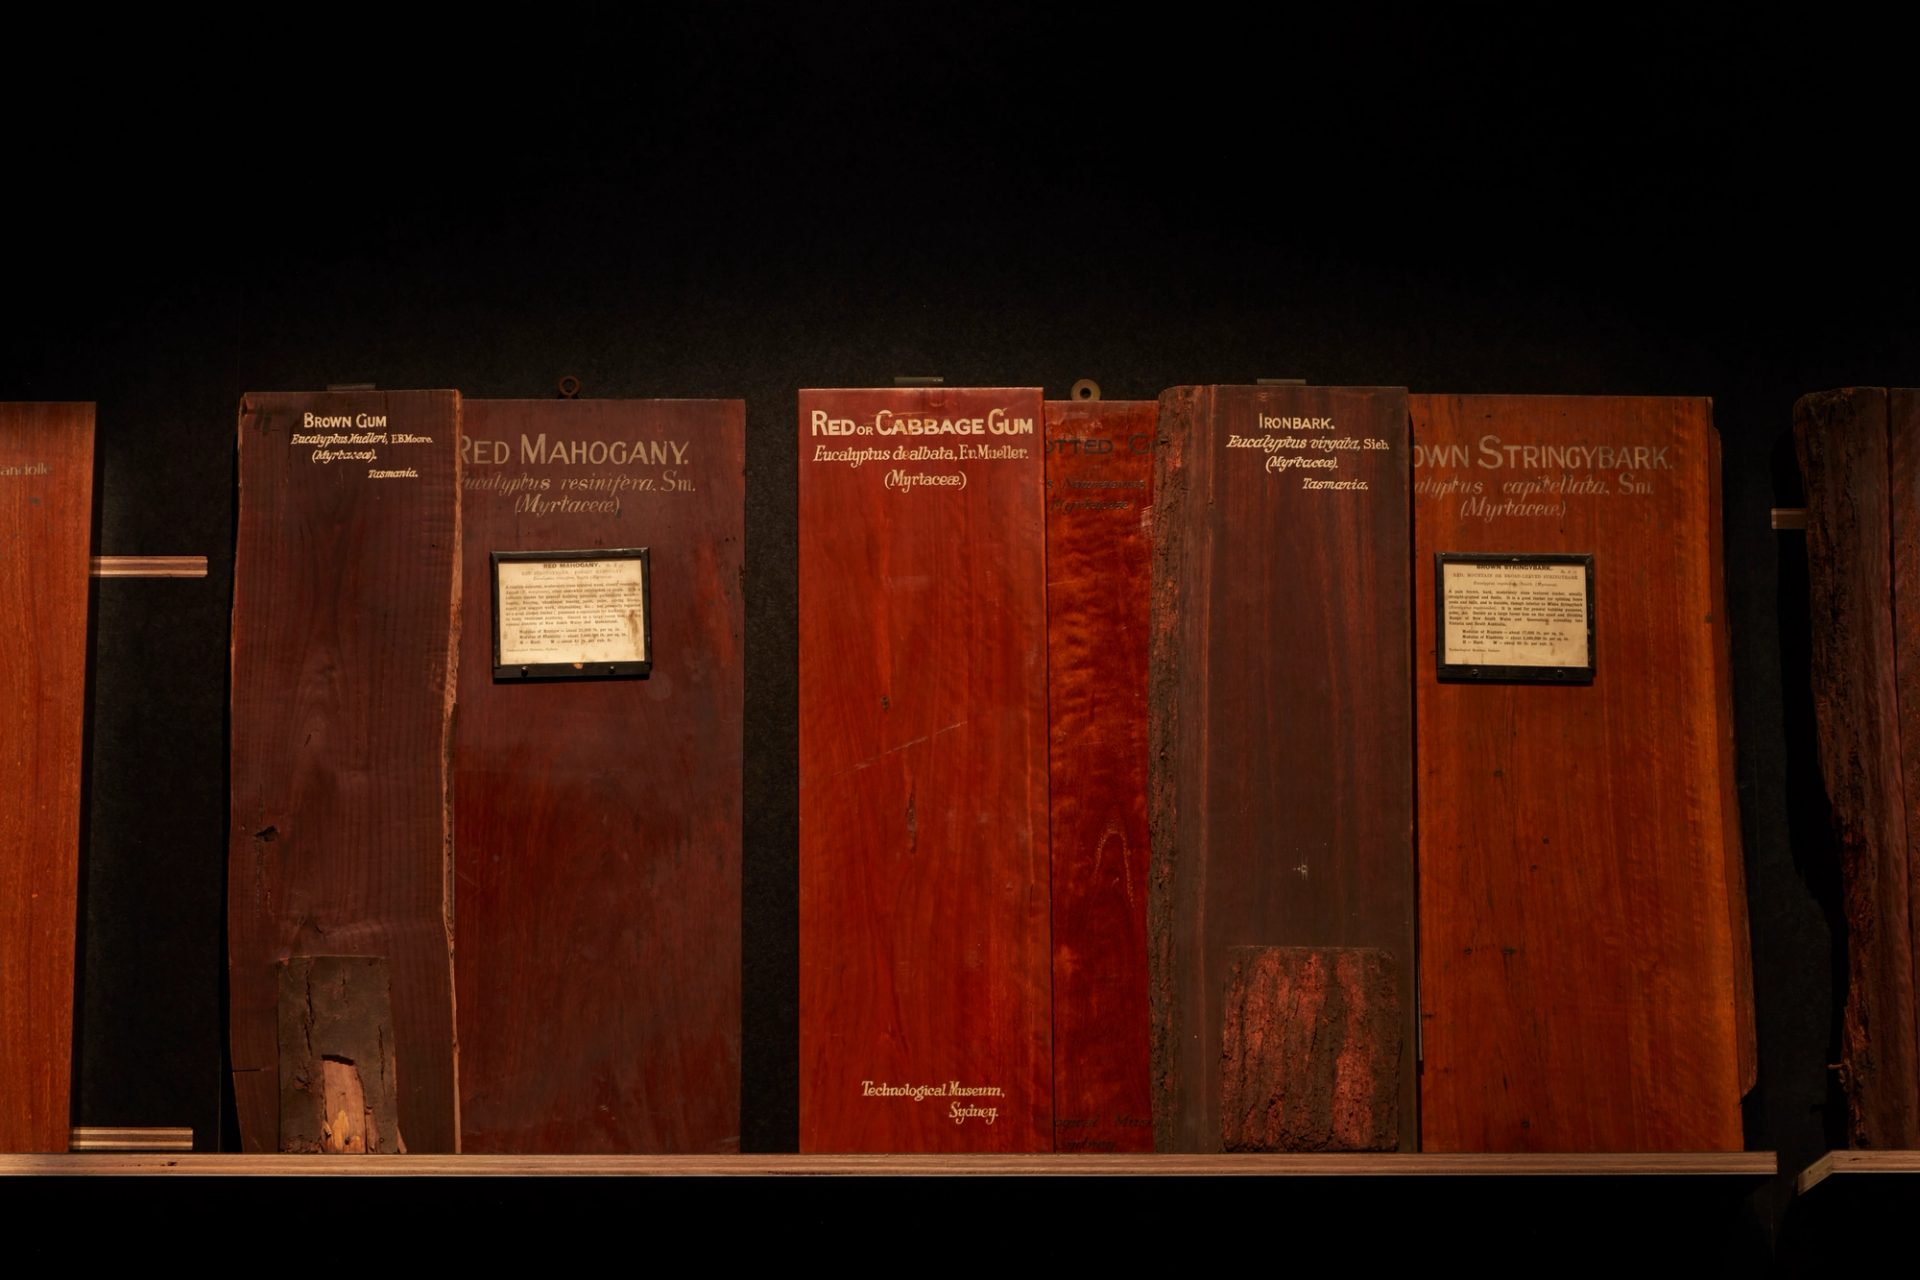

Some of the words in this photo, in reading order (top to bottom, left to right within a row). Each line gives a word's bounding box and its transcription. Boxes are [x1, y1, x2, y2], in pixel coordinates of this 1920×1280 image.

[303, 412, 351, 428] BROWN
[356, 413, 387, 428] GUM
[812, 410, 855, 436] RED
[856, 425, 874, 436] OR
[875, 410, 985, 436] CABBAGE
[988, 408, 1033, 435] GUM
[1259, 413, 1335, 430] IRONBARK.
[290, 433, 349, 448] Eucalyptus
[521, 433, 690, 466] MAHOGANY.
[1226, 435, 1308, 452] Eucalyptus
[1309, 436, 1361, 453] virgata,
[1363, 439, 1390, 451] Sieb.
[1477, 434, 1673, 470] STRINGYBARK.
[813, 444, 891, 469] Eucalyptus
[892, 445, 958, 463] dealbata,
[368, 467, 419, 479] Tasmania.
[660, 469, 697, 493] Sm.
[1302, 477, 1369, 491] Tasmania.
[1502, 472, 1611, 503] capitellata,
[861, 1080, 947, 1102] Technological
[946, 1080, 1006, 1099] Museum,
[949, 1101, 1000, 1126] Sydney.
